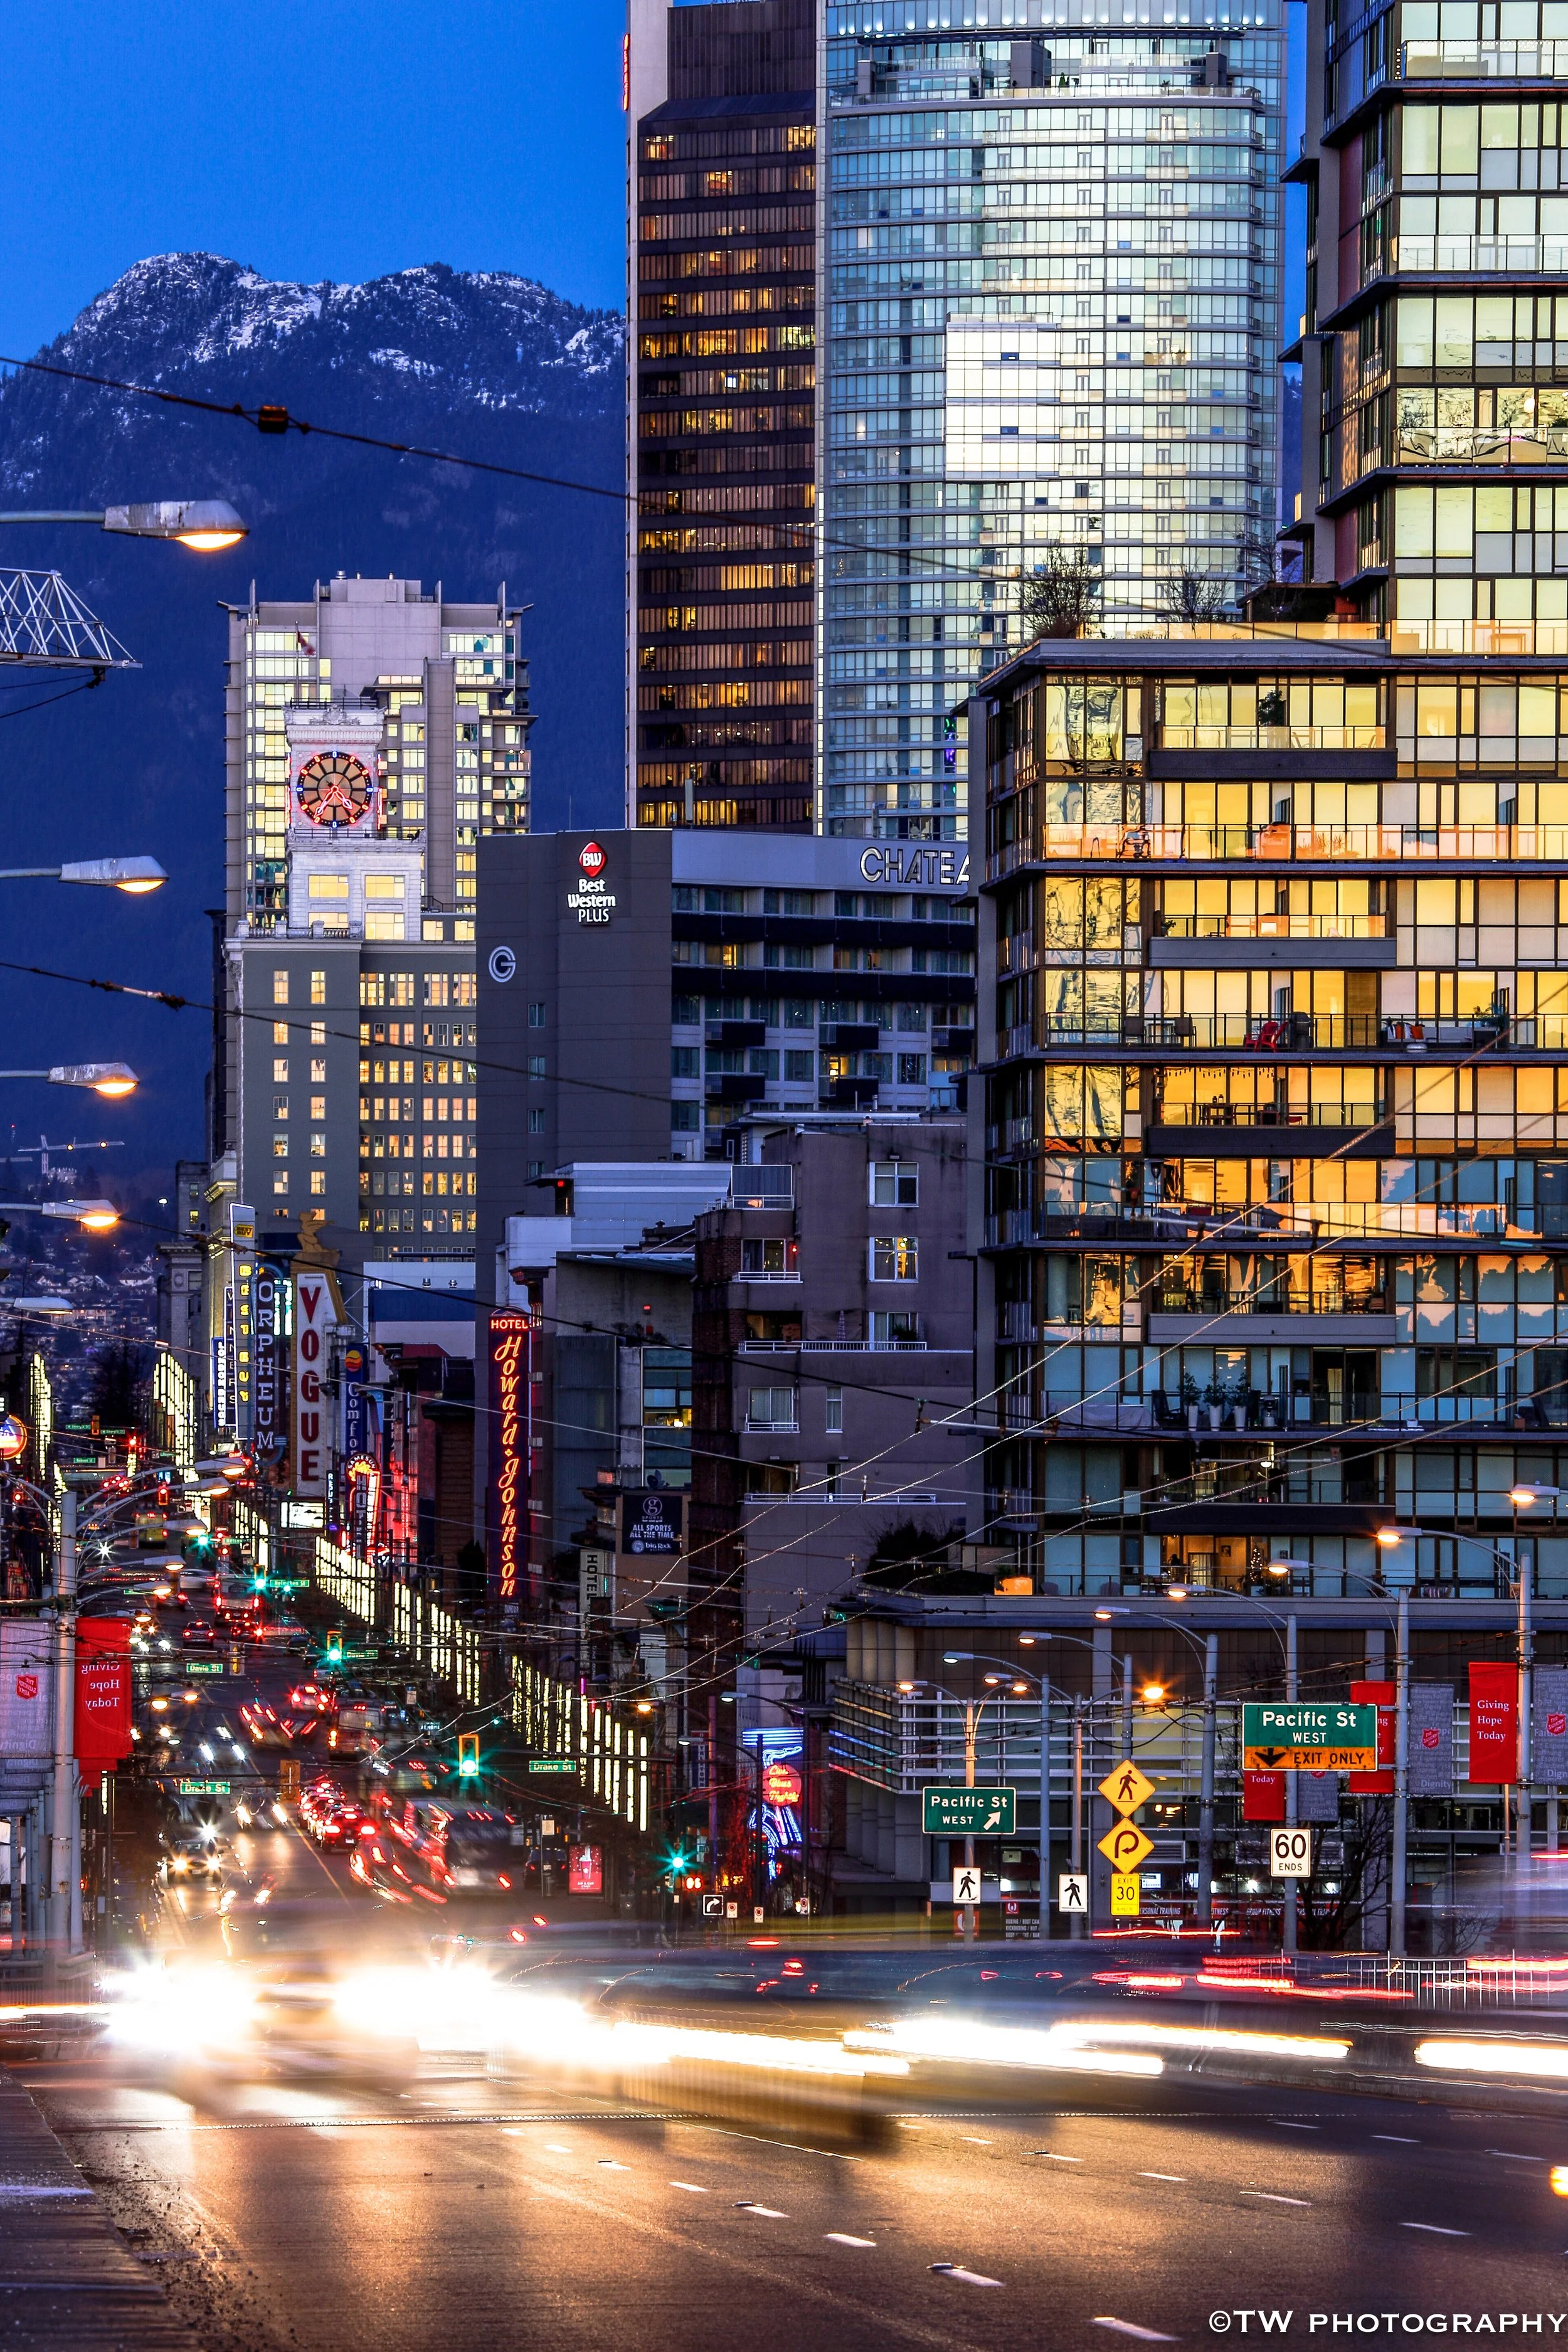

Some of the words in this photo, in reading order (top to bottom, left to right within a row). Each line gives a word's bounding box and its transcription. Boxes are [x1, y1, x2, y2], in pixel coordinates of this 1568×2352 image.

[583, 853, 602, 866] BW
[578, 879, 606, 893] Best
[568, 894, 616, 908] Western
[578, 909, 610, 922] PLUS
[239, 1264, 252, 1335] BEST
[491, 1320, 528, 1329] HOTEL
[257, 1281, 273, 1449] ORPHEUM
[239, 1351, 250, 1402] BUY
[299, 1287, 321, 1481] VOGUE
[494, 1336, 522, 1445] Howard
[347, 1454, 376, 1469] SAMESUN
[499, 1458, 519, 1596] Johnson
[586, 1555, 598, 1600] HOTEL
[1477, 1700, 1510, 1712] Giving
[1263, 1711, 1327, 1727] Pacific
[1336, 1711, 1356, 1727] St
[1477, 1715, 1502, 1727] Hope
[1293, 1732, 1327, 1744] WEST
[1476, 1731, 1506, 1742] Today
[1294, 1752, 1322, 1764] EXIT
[1330, 1752, 1365, 1765] ONLY
[534, 1762, 559, 1771] Drake
[562, 1762, 572, 1771] St
[769, 1777, 792, 1788] Blues
[1251, 1775, 1276, 1784] Today
[1421, 1779, 1451, 1789] Dignity
[215, 1784, 226, 1793] St
[931, 1796, 984, 1808] Pacific
[991, 1796, 1007, 1808] St
[942, 1816, 973, 1825] WEST
[1275, 1833, 1306, 1859] 60
[1279, 1863, 1302, 1871] ENDS
[1116, 1886, 1135, 1900] 30
